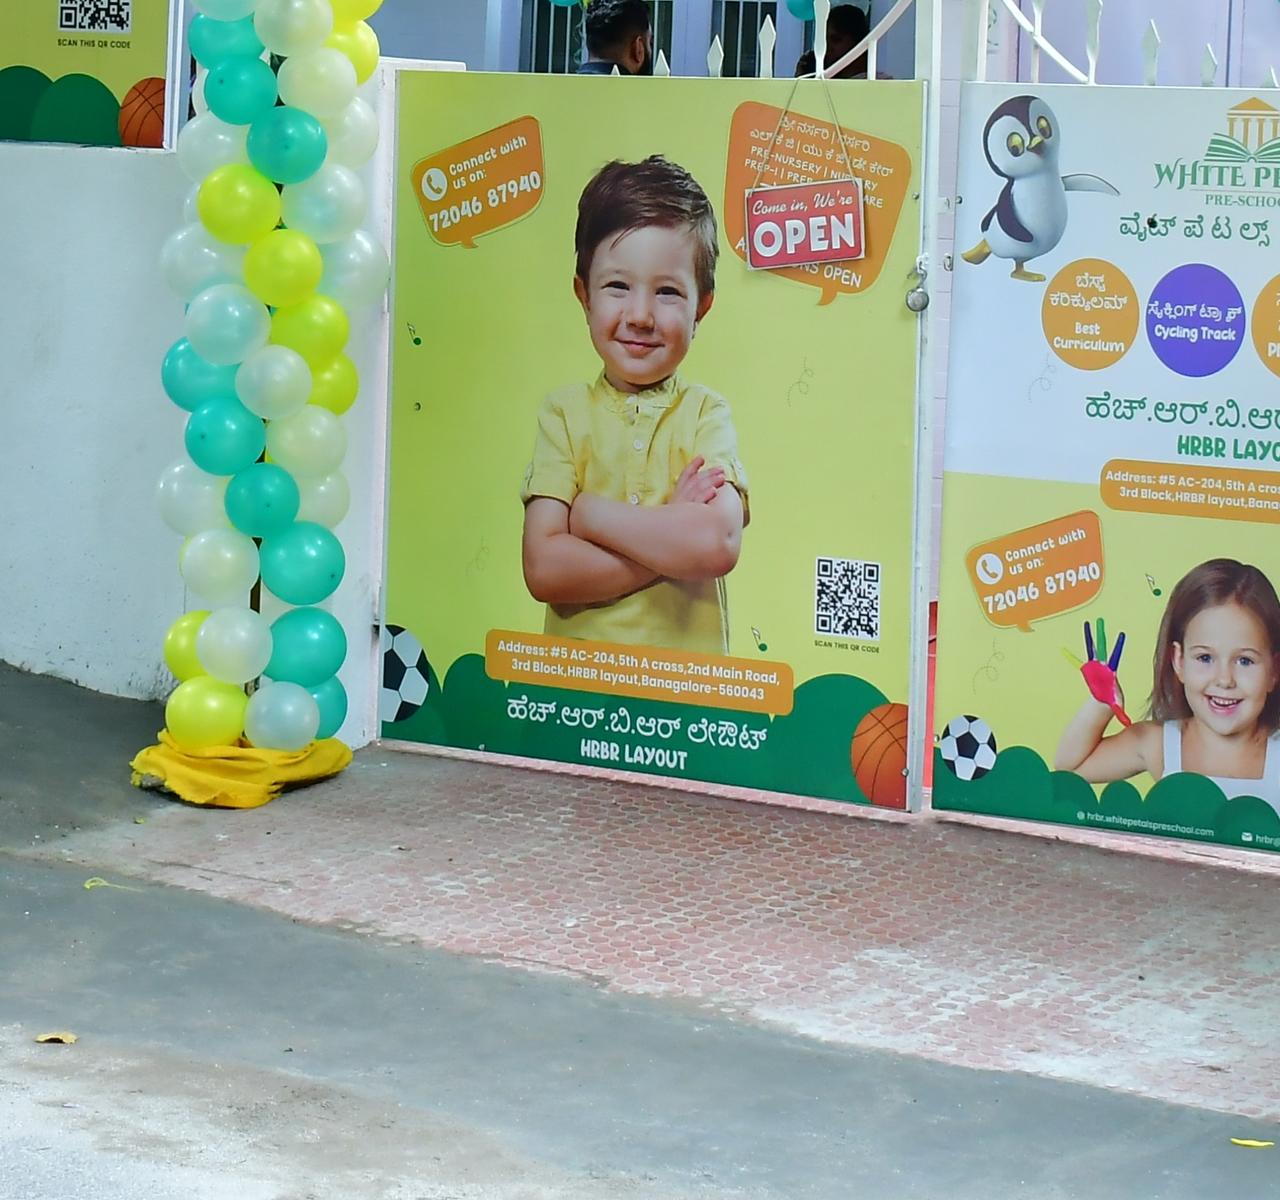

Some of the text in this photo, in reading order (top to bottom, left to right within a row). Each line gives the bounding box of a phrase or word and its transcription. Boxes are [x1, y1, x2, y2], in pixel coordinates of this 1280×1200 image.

[58, 39, 78, 47] SCAN
[98, 40, 108, 48] QR
[111, 41, 131, 49] CODE
[449, 136, 527, 175] Connect with
[751, 145, 822, 173] PRE-NURSERY
[453, 169, 487, 189] us on:
[1154, 158, 1246, 190] WHITE
[429, 171, 540, 232] 72046 87940
[752, 190, 853, 216] Come in, We're
[754, 213, 855, 257] OPEN
[824, 264, 862, 288] OPEN
[1075, 322, 1100, 335] Best
[1154, 324, 1236, 342] Cycling Track
[1053, 336, 1125, 352] Curriculum
[1178, 435, 1226, 458] HRBR
[1106, 470, 1156, 485] Address:
[1158, 474, 1176, 487] #5
[1178, 476, 1245, 493] AC-204,5th
[1247, 482, 1256, 492] A
[1120, 487, 1138, 499] 3rd
[1141, 488, 1206, 505] Block,HRBR
[1005, 528, 1086, 562] Connect with
[1009, 563, 1023, 576] us
[984, 562, 1100, 614] 72046 87940
[814, 640, 832, 648] SCAN
[834, 642, 848, 650] THIS
[861, 646, 880, 654] CODE
[498, 640, 780, 686] Address: #5 AC-204,5th A cross,2nd Main Road,
[511, 658, 764, 700] 3rd Block,HRBR layout,Banagalore-560043
[507, 695, 681, 738] ಹೆಚ್.ಆರ್.ಬಿ.ಆರ್
[581, 738, 688, 770] HRBR LAYOUT
[1086, 811, 1215, 837] hrbr.whitepetalspreschool.com
